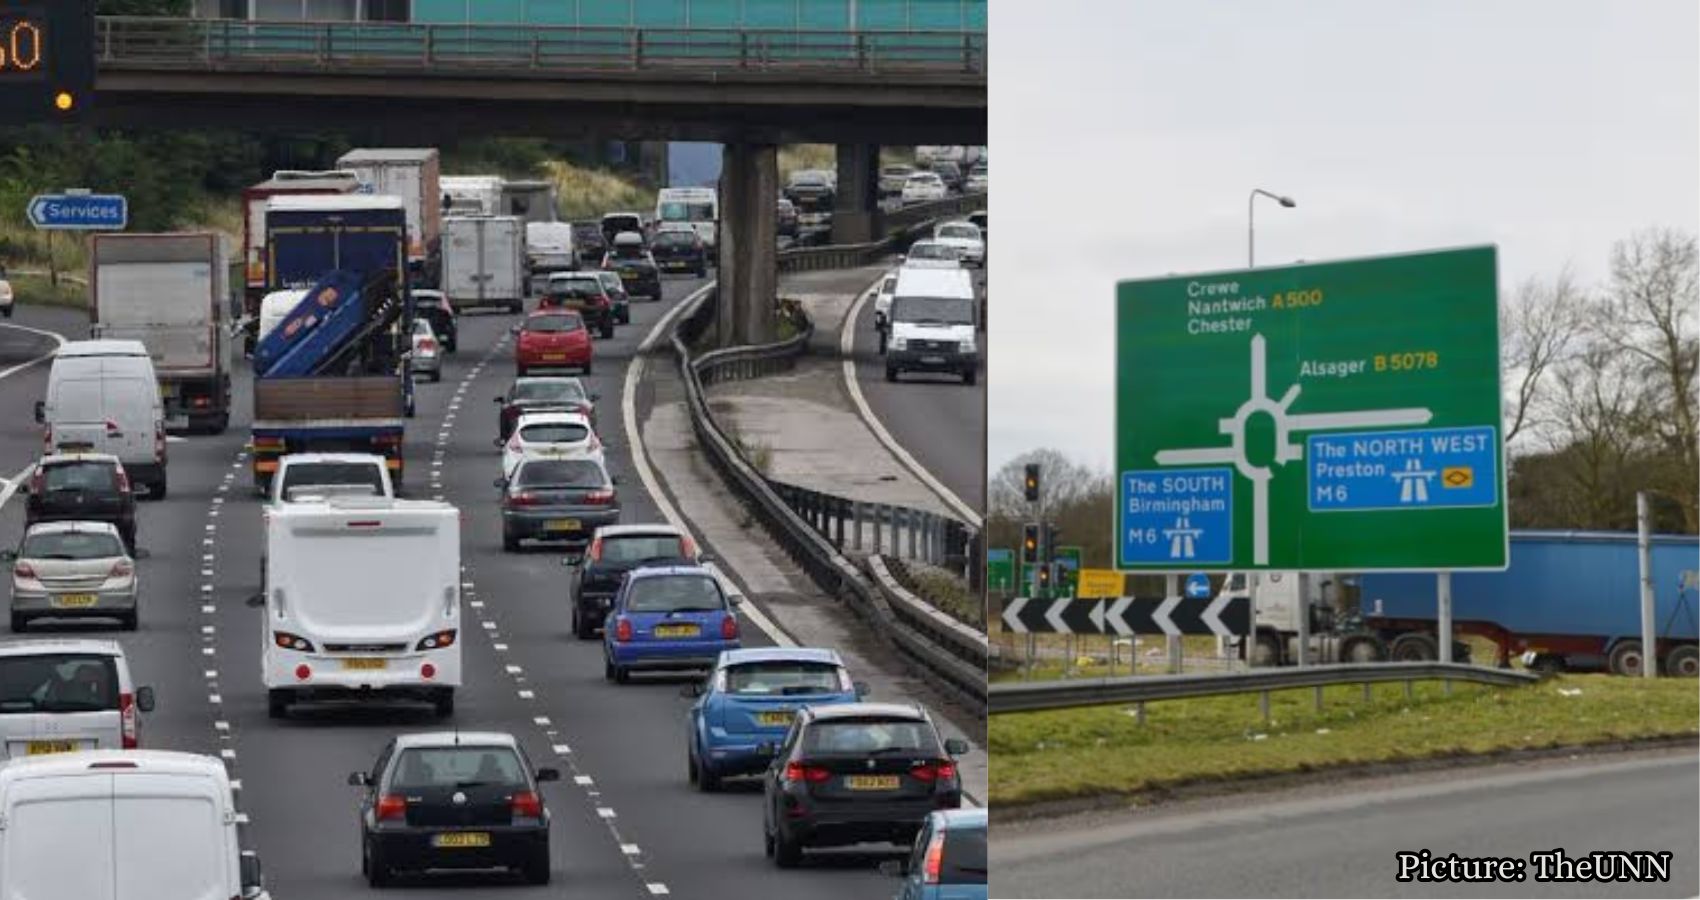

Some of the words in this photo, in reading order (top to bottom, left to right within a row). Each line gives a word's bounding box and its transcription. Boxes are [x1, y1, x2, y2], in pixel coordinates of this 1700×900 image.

[0, 21, 40, 70] 0
[47, 203, 118, 219] Services
[1187, 281, 1240, 297] Crewe
[1188, 296, 1266, 316] Nantwich
[1187, 316, 1252, 335] Chester
[1300, 357, 1366, 378] Alsager
[1314, 441, 1346, 459] The
[1353, 437, 1424, 457] NORTH
[1431, 433, 1490, 453] WEST
[1315, 460, 1386, 478] Preston
[1128, 478, 1157, 494] The
[1161, 476, 1225, 494] SOUTH
[1128, 496, 1226, 516] Birmingham
